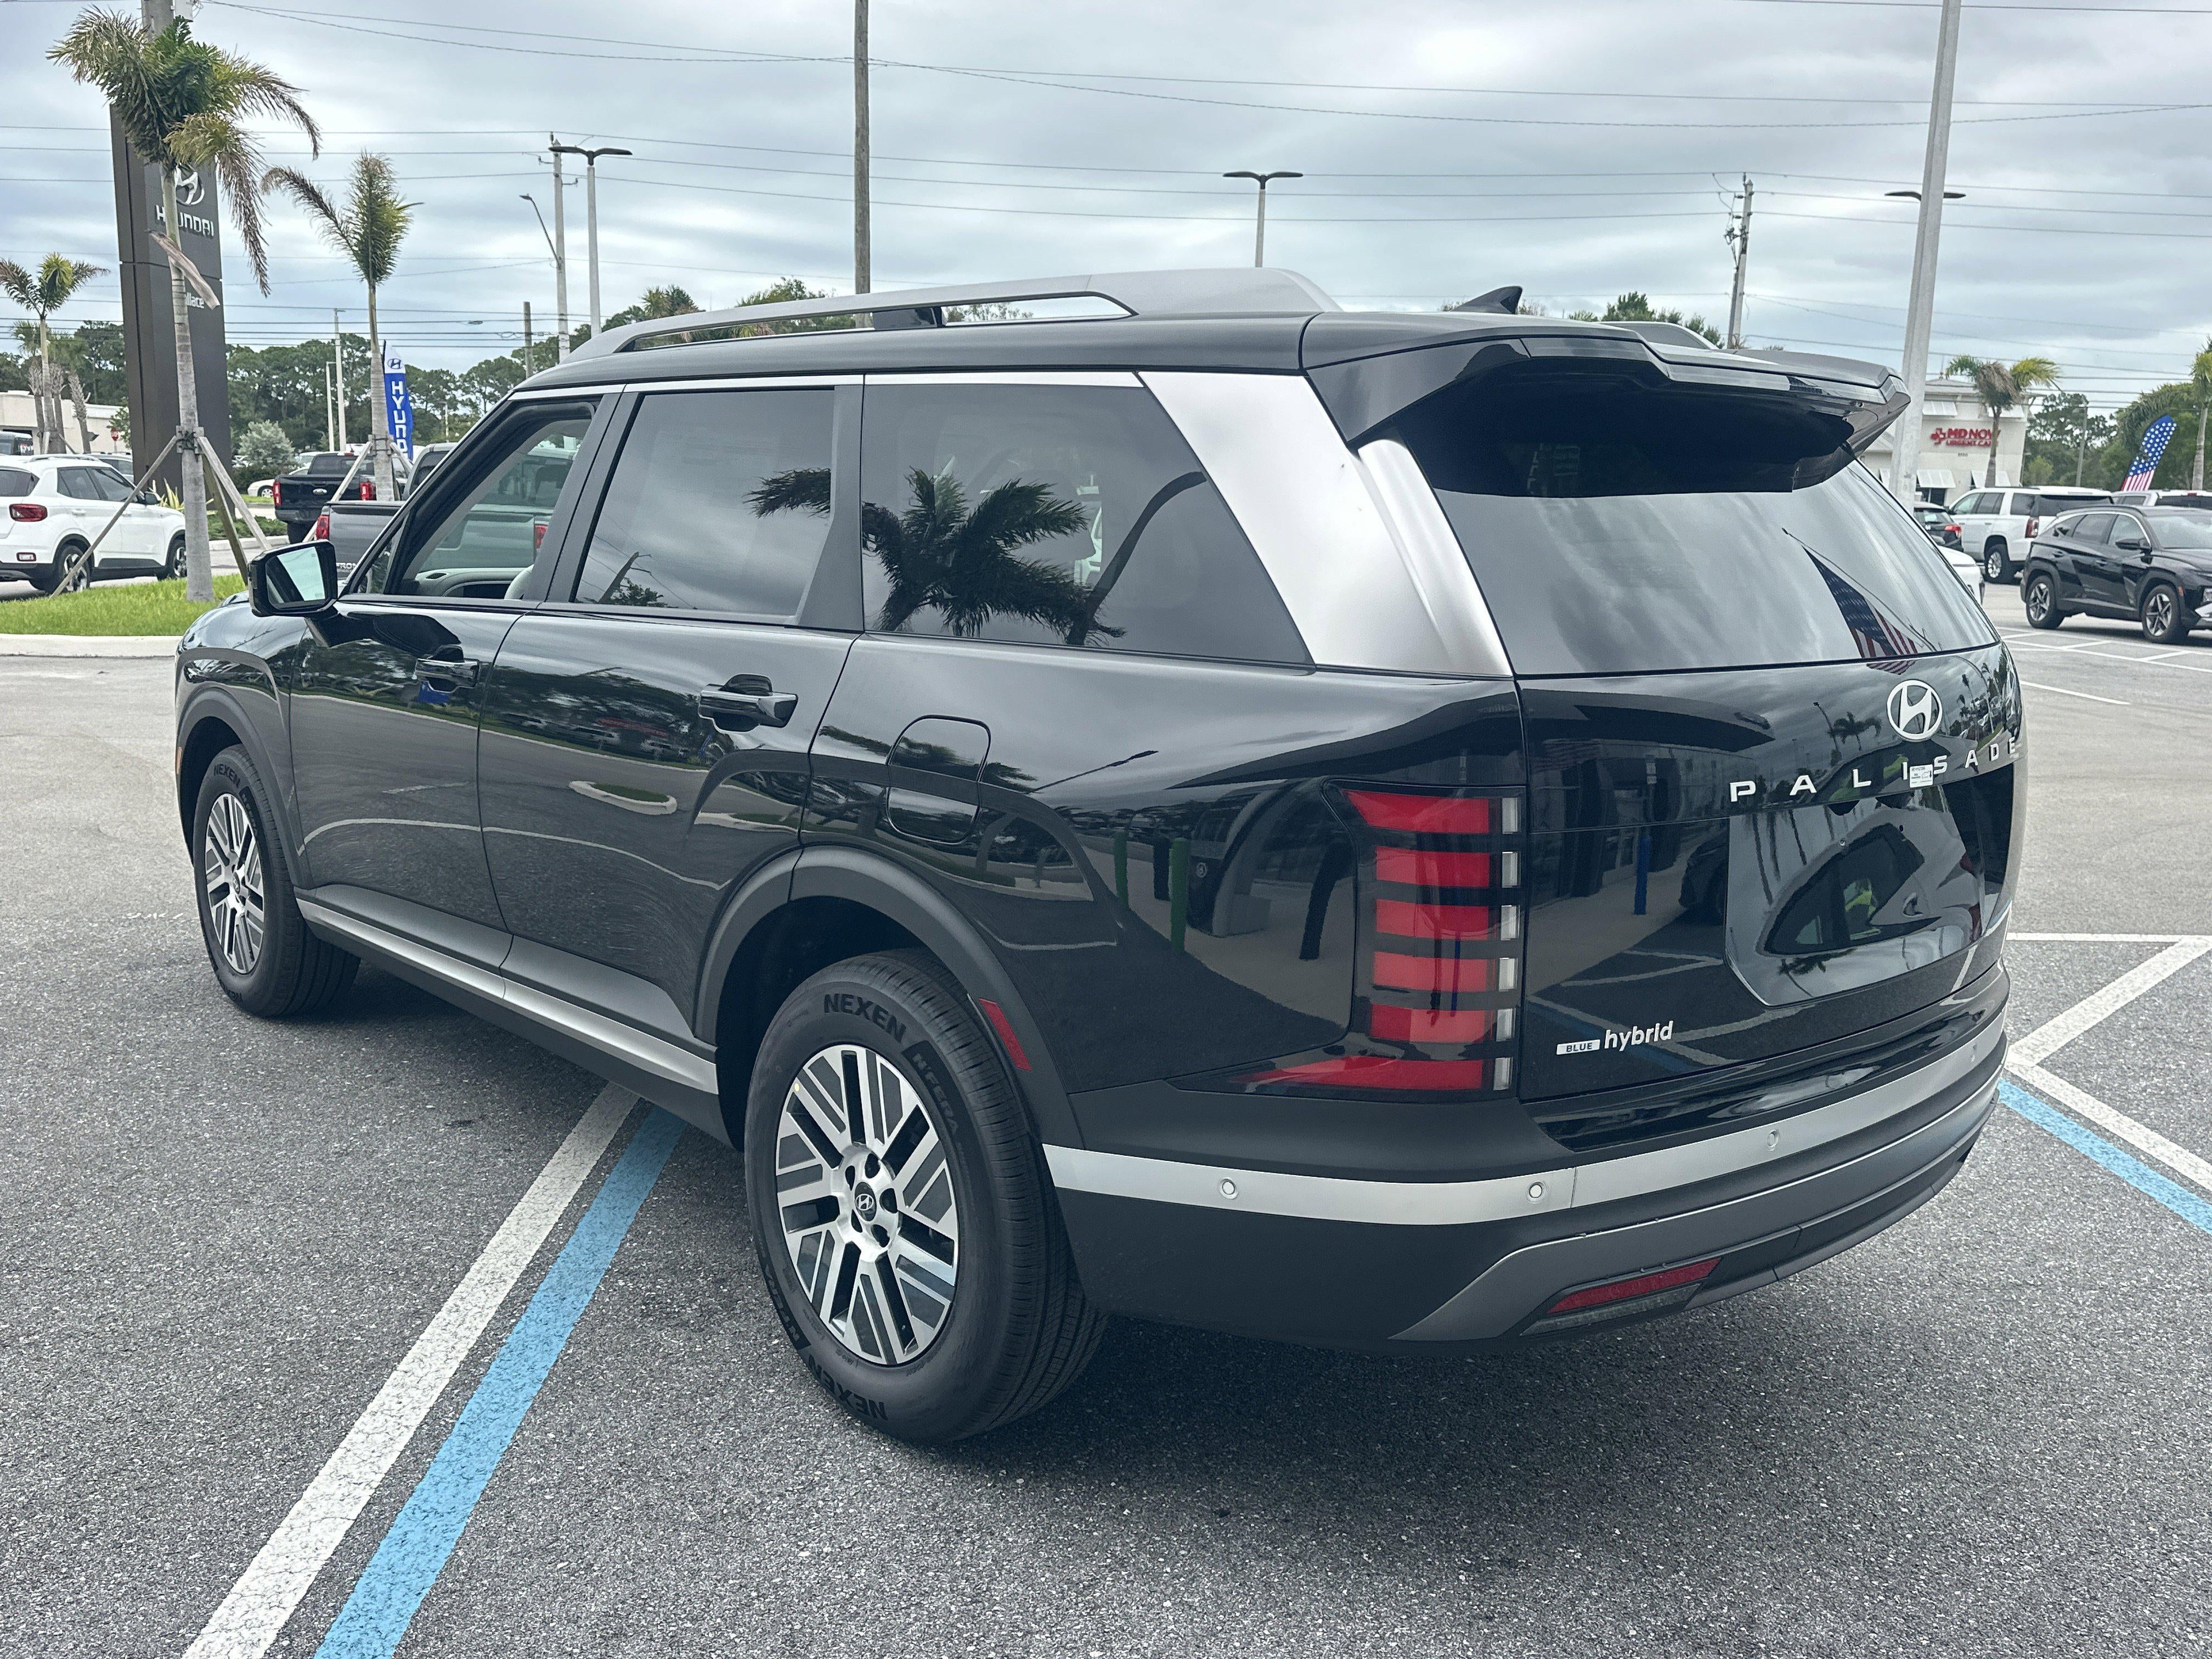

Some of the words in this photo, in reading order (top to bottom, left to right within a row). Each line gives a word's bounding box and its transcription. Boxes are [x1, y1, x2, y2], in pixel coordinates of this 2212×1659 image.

[156, 205, 214, 236] HUNDAI
[1948, 428, 1968, 439] MD
[1730, 736, 2016, 802] PALISADE
[824, 993, 907, 1042] NEXEN
[1566, 1042, 1593, 1053] BLUE
[1604, 1020, 1674, 1052] hybrid
[808, 1354, 889, 1421] NEXEN
